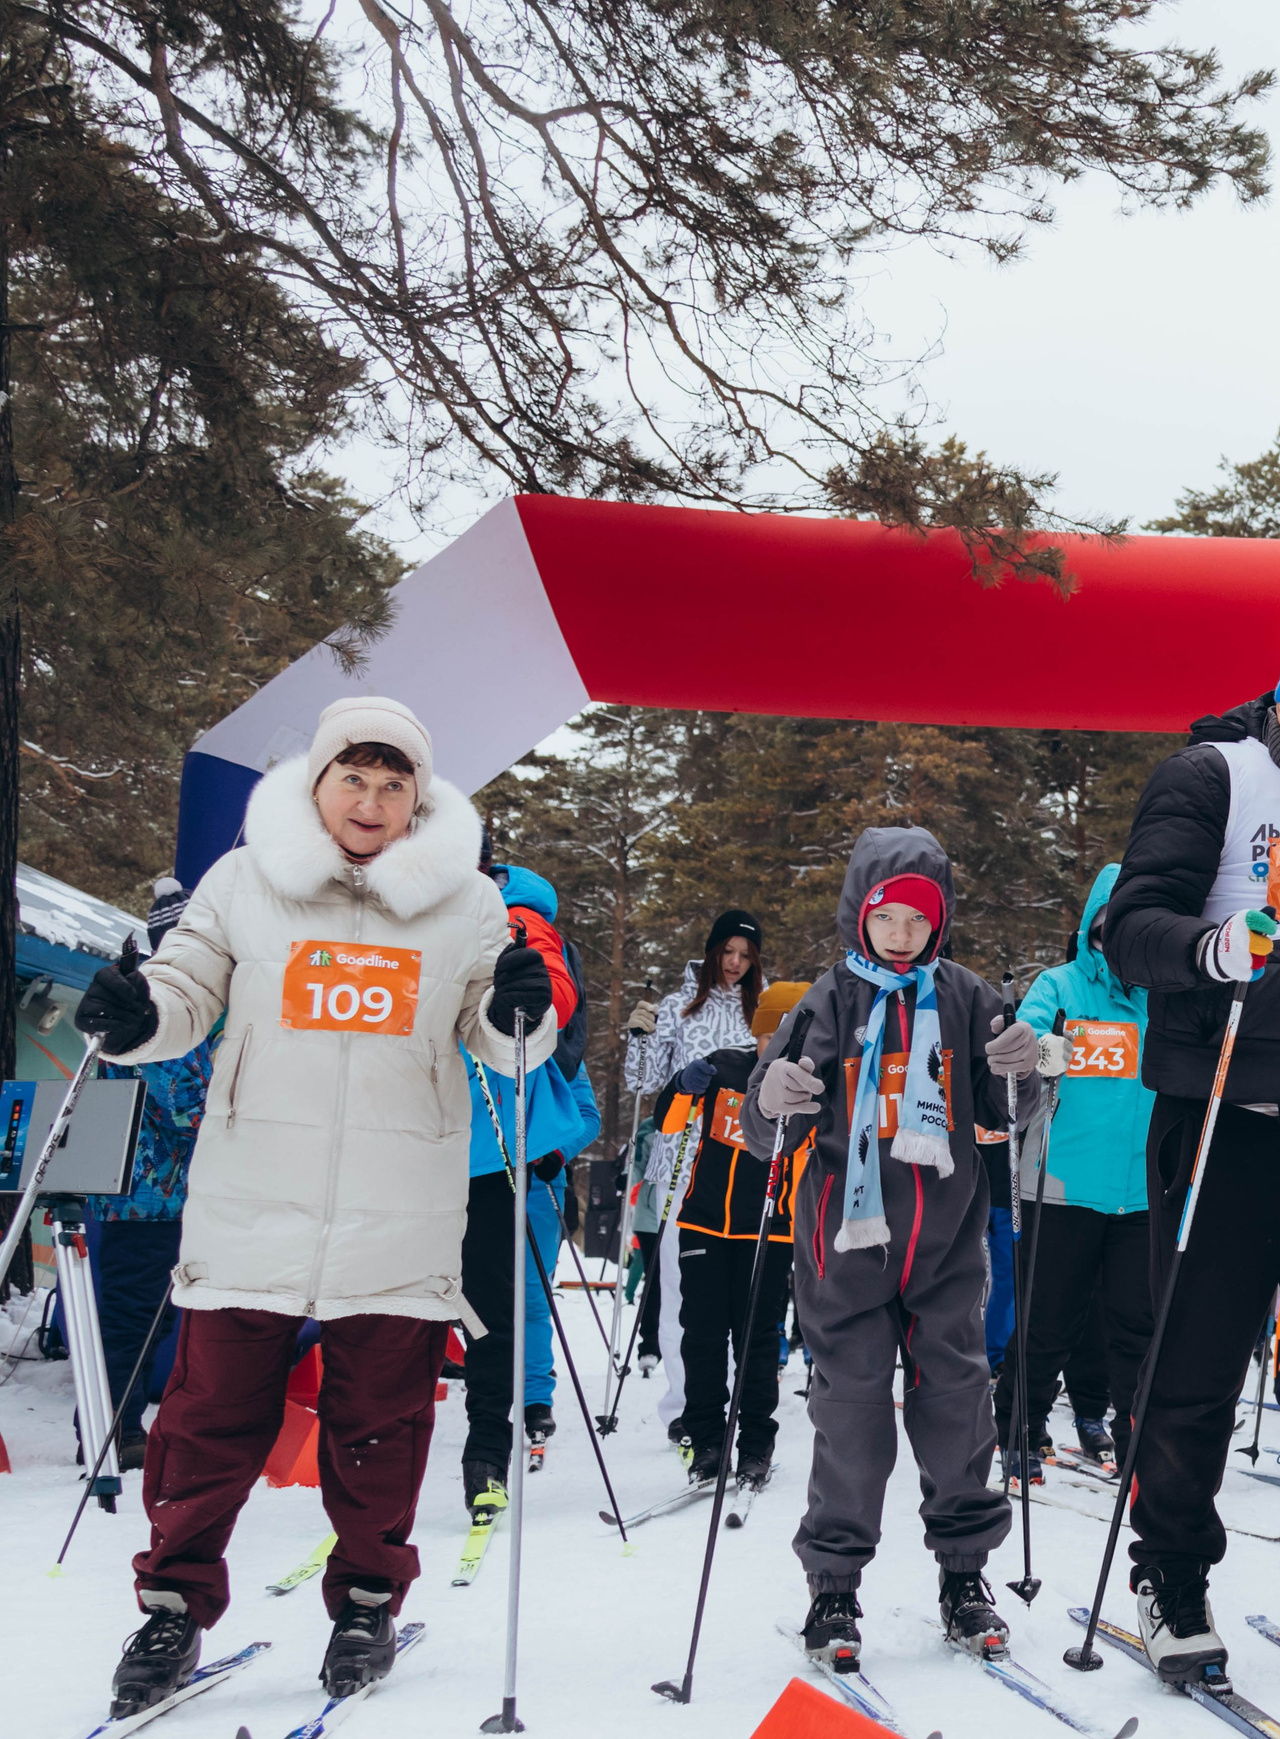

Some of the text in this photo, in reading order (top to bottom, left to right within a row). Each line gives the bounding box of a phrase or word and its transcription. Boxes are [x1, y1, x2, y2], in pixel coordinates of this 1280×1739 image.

[336, 953, 400, 970] Goodline
[306, 983, 393, 1023] 109
[1087, 1027, 1126, 1037] Goodline
[1069, 1046, 1125, 1071] 343
[917, 1100, 947, 1116] МИНС
[921, 1114, 949, 1129] РОСС
